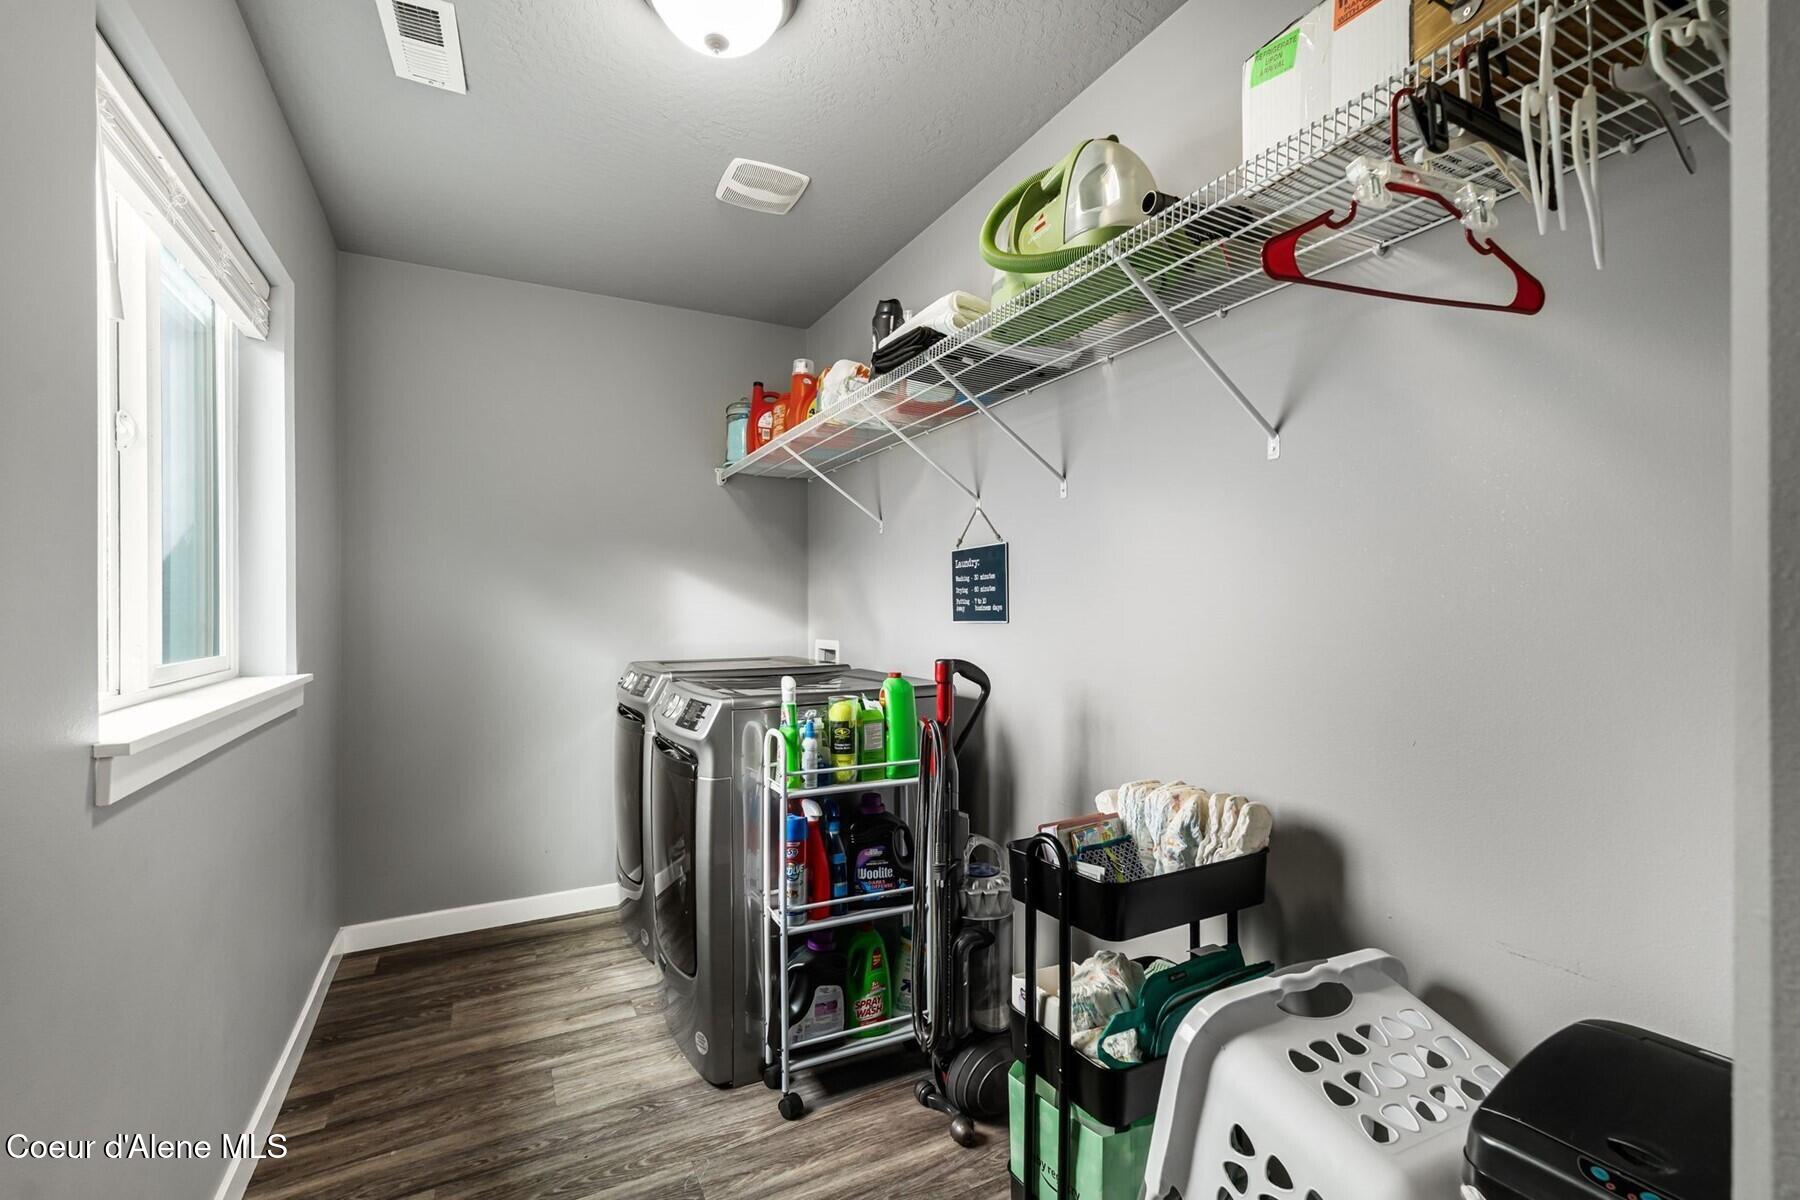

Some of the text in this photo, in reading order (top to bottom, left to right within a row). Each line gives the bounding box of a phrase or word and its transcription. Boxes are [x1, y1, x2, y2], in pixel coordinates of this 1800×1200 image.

[1255, 34, 1298, 63] REFRIGERATE
[1265, 51, 1283, 66] UPON
[857, 866, 893, 880] Woolite
[855, 996, 882, 1010] SPRAY
[856, 1004, 883, 1018] WASH
